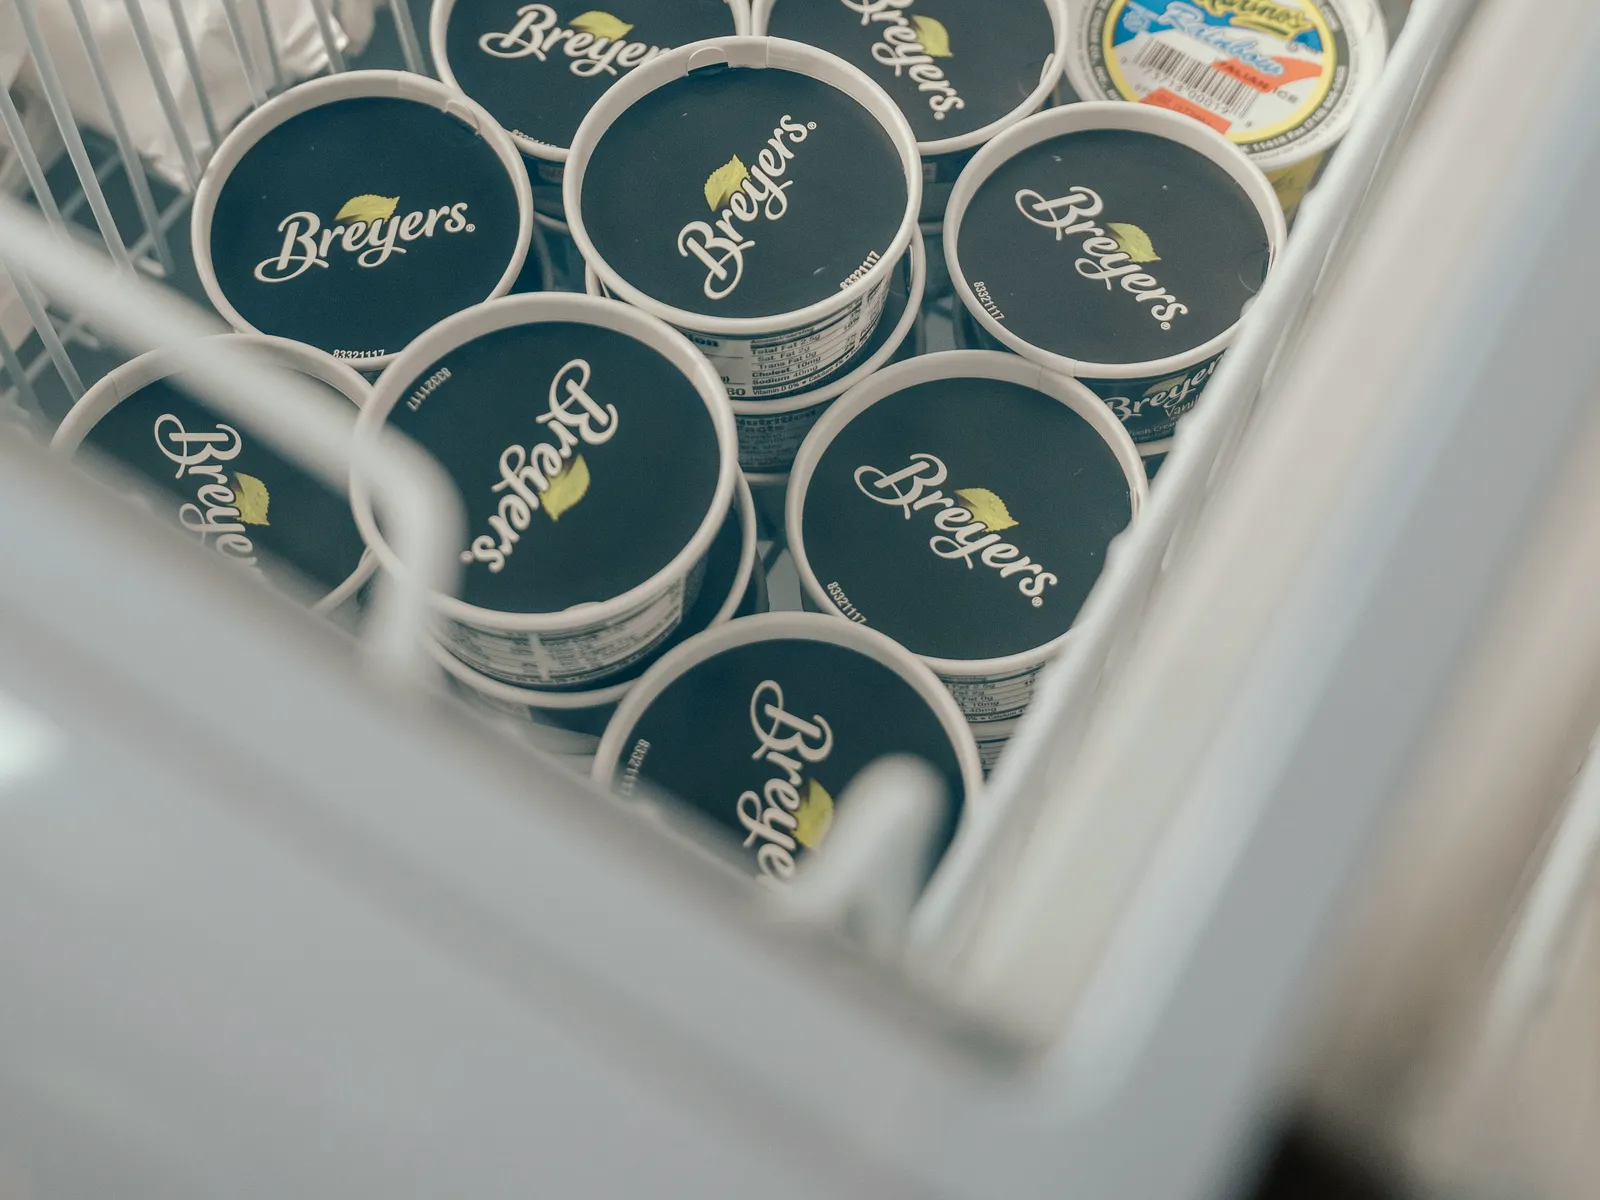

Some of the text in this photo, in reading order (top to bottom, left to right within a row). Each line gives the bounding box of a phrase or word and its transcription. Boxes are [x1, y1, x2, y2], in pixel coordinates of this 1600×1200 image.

[479, 3, 671, 77] Breyer
[677, 114, 817, 300] Breyers
[254, 202, 476, 283] Breyers
[1014, 185, 1189, 331] Breyers
[839, 250, 881, 289] 83321117
[973, 281, 1005, 320] 83321117
[333, 348, 386, 359] 83321117
[751, 347, 778, 355] Total
[780, 342, 798, 351] Fat
[751, 355, 821, 378] Cholest. 10mg
[759, 351, 818, 370] Trans Fat 0g
[780, 349, 796, 358] Fat
[798, 345, 810, 354] 2g
[752, 364, 819, 386] Sodium 40mg
[752, 386, 780, 396] Vitamin
[788, 381, 800, 390] 0%
[1102, 353, 1225, 423] Breyer
[460, 358, 619, 571] Breyers
[153, 413, 258, 567] Breye
[853, 453, 1058, 607] Breyers
[827, 581, 868, 624] 83321117
[736, 679, 834, 883] Breye
